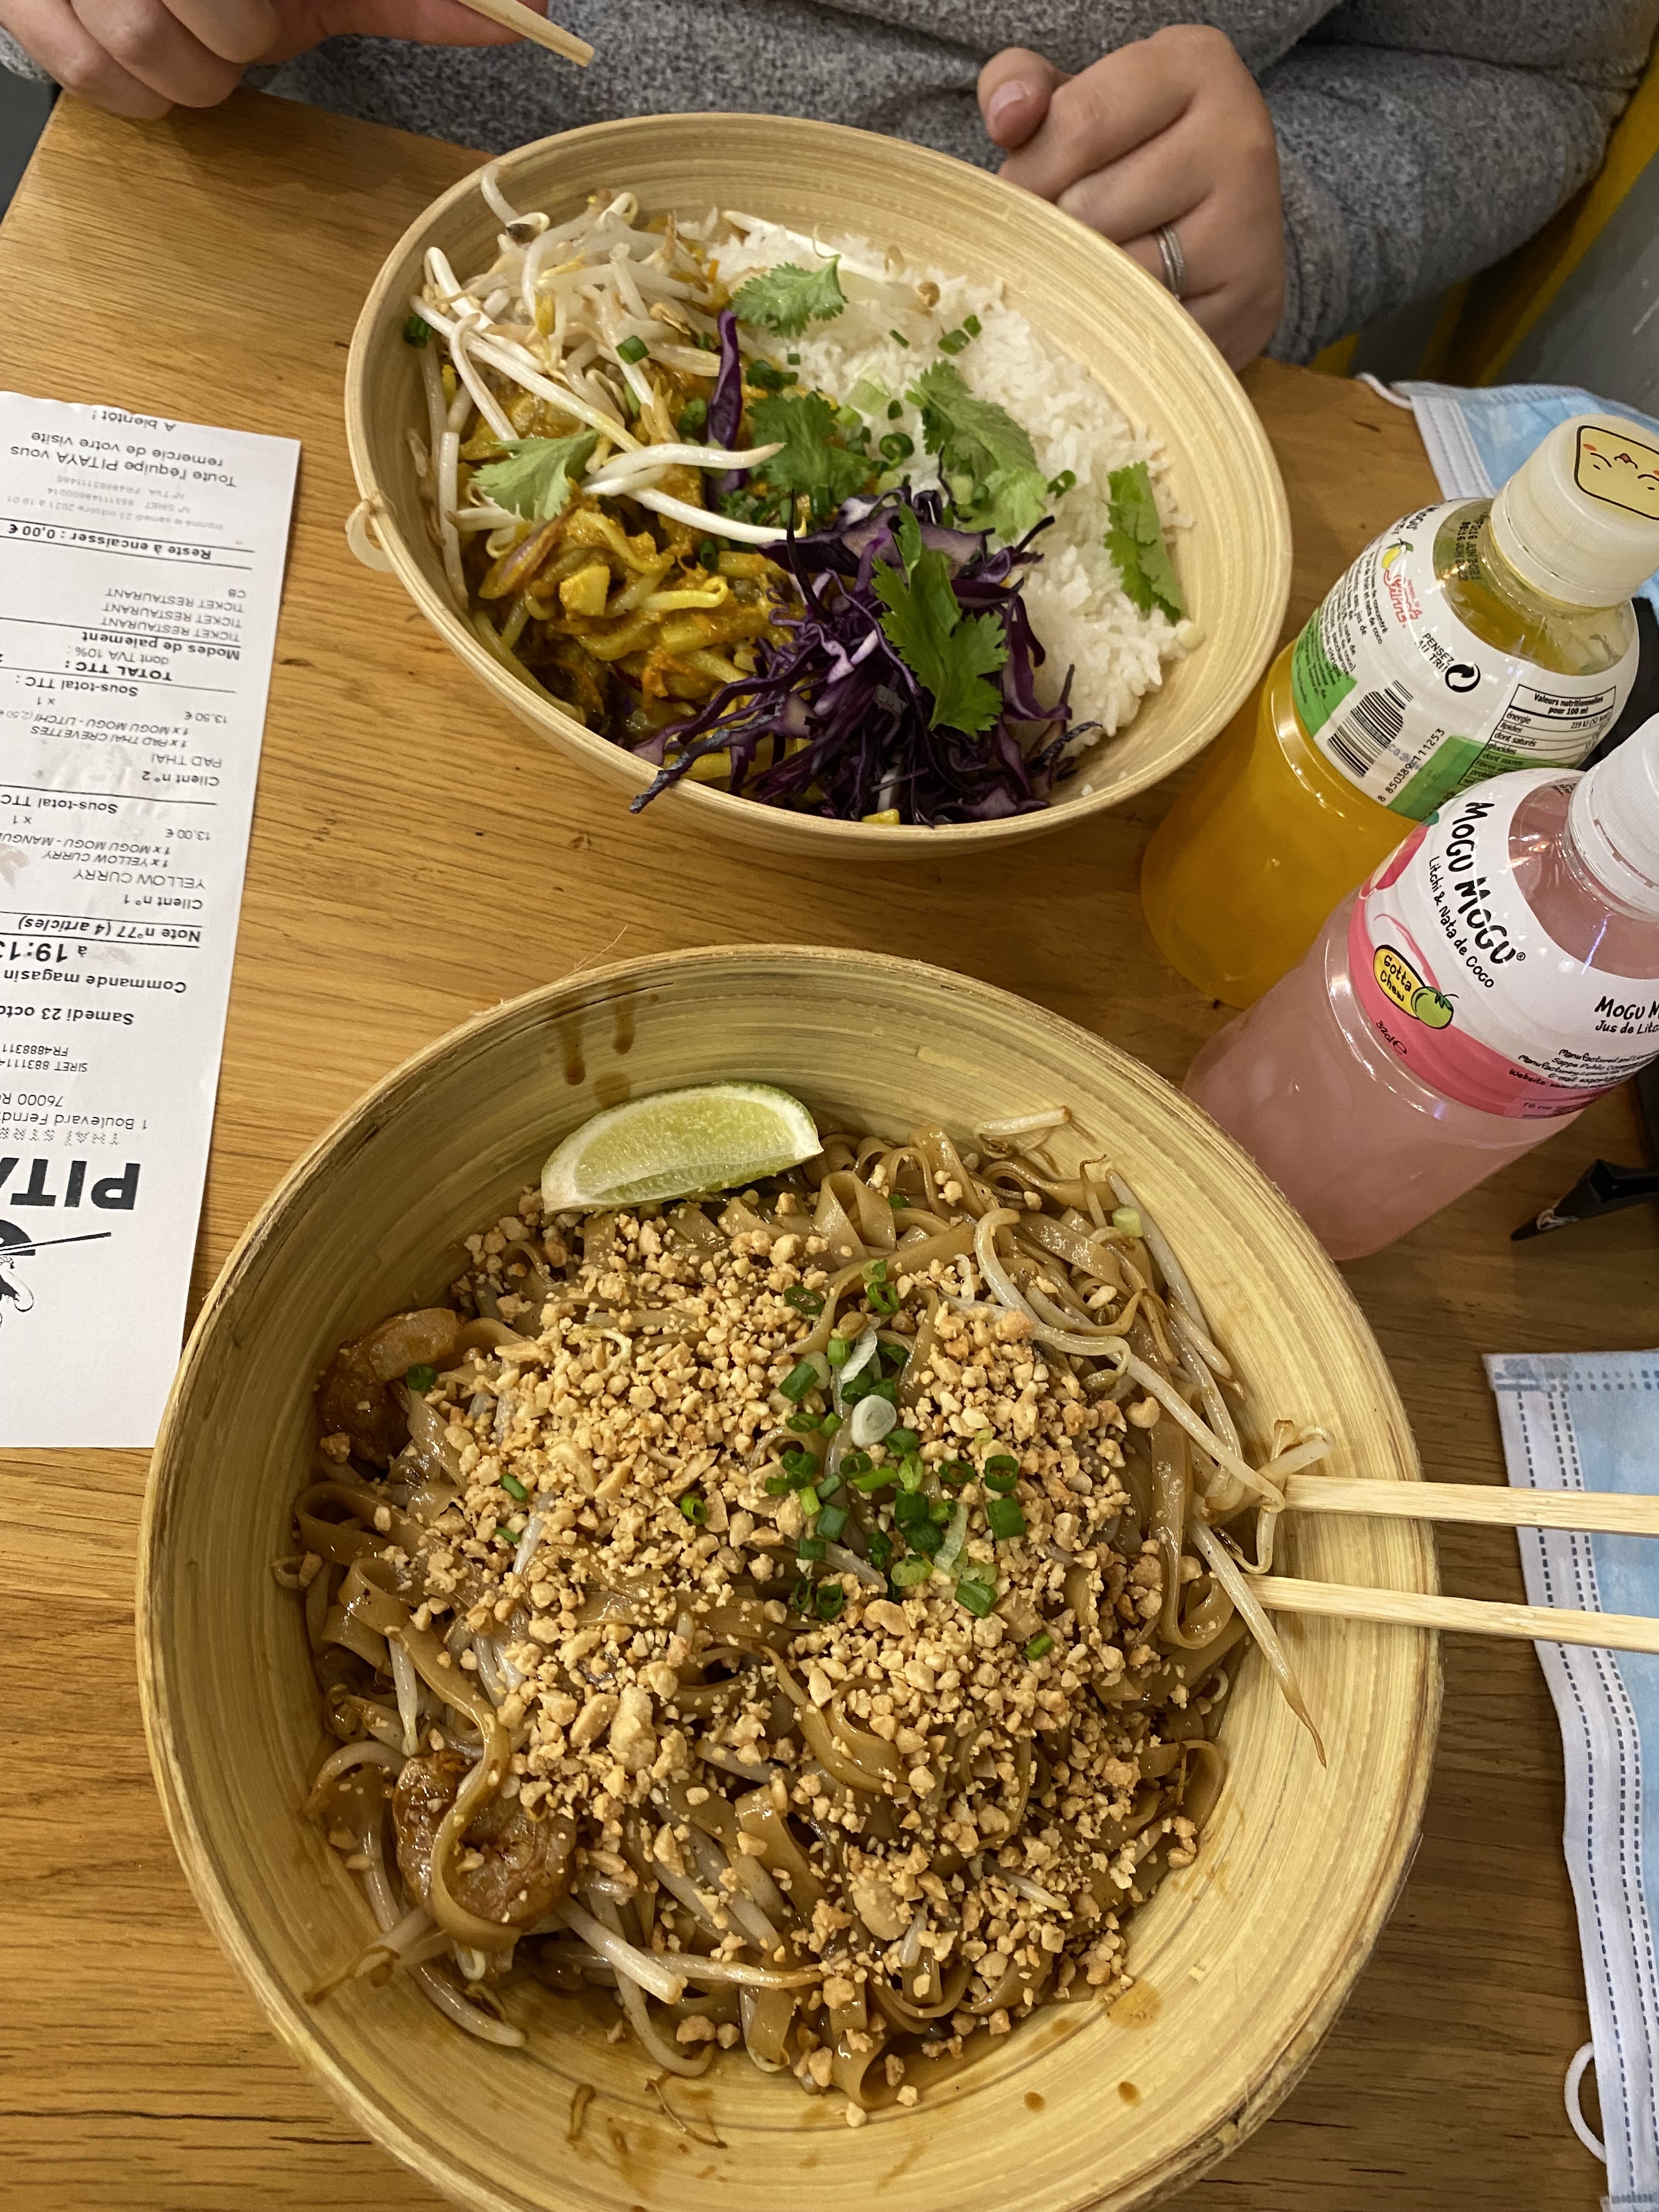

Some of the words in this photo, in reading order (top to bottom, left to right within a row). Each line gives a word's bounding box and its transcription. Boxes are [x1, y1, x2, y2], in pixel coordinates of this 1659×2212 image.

[102, 410, 157, 430] bientôt
[165, 422, 176, 432] A
[31, 432, 72, 447] visite
[79, 439, 119, 453] votre
[10, 446, 49, 460] vous
[126, 446, 146, 459] de
[153, 449, 223, 469] remercie
[57, 452, 118, 471] PITAYA
[125, 460, 186, 480] l'équipe
[193, 471, 235, 487] Toute
[8, 523, 18, 534] €
[23, 526, 55, 539] 0,00
[71, 533, 148, 550] encaisser
[154, 544, 162, 554] à
[168, 546, 211, 560] Reste
[105, 588, 194, 607] RESTAURANT
[228, 589, 246, 599] CB
[102, 603, 191, 622] RESTAURANT
[198, 600, 244, 613] TICKET
[99, 617, 189, 636] RESTAURANT
[196, 615, 242, 627] TICKET
[81, 631, 157, 648] paiement
[195, 629, 240, 641] TICKET
[75, 647, 103, 657] 10%
[163, 642, 182, 653] de
[188, 645, 240, 661] Modes
[109, 651, 135, 662] TVA
[140, 654, 168, 665] dont
[76, 662, 108, 674] TTC
[117, 666, 172, 681] TOTAL
[25, 677, 55, 689] TTC
[61, 681, 138, 697] Sous-total
[1534, 693, 1559, 706] Valeurs
[34, 714, 76, 726] LITCHI
[1506, 711, 1531, 724] énergie
[86, 719, 127, 731] MOGU
[130, 724, 171, 735] MOGU
[1499, 722, 1522, 733] lipides
[31, 726, 107, 741] CREVETTES
[110, 735, 139, 744] THAI
[1494, 731, 1511, 741] dont
[1513, 737, 1537, 747] saturés
[142, 737, 168, 747] PAD
[151, 754, 186, 765] THAI
[192, 756, 222, 768] PAD
[142, 771, 150, 780] 2
[176, 775, 219, 786] Client
[1, 794, 31, 806] TTC
[38, 798, 118, 814] Sous-total
[165, 829, 173, 837] €
[1446, 802, 1495, 872] MOGU
[64, 839, 106, 850] MOGU
[109, 843, 151, 854] MOGU
[43, 850, 90, 862] CURRY
[93, 854, 148, 867] YELLOW
[73, 869, 132, 883] CURRY
[1429, 856, 1444, 892] Litchi
[137, 874, 205, 889] YELLOW
[124, 895, 129, 904] 1
[158, 896, 202, 910] Client
[1434, 891, 1445, 906] &
[18, 916, 89, 932] articles)
[1439, 905, 1457, 939] Nata
[94, 922, 111, 936] (4
[162, 929, 201, 942] Note
[77, 945, 87, 957] à
[1454, 938, 1468, 956] de
[4, 969, 80, 983] magasin
[1384, 955, 1412, 992] Gotta
[1466, 956, 1494, 988] Coco
[86, 976, 187, 993] Commande
[1380, 970, 1404, 1001] Chew
[42, 1008, 62, 1020] 23
[1594, 996, 1645, 1020] MOGU
[66, 1008, 134, 1025] Samedi
[1596, 1020, 1617, 1033] Jus
[1620, 1022, 1634, 1034] de
[3, 1044, 68, 1056] FR4888311
[54, 1062, 88, 1072] SIRET
[18, 1094, 64, 1107] 76000
[0, 1112, 48, 1125] Fernd
[54, 1115, 134, 1130] Boulevard
[142, 1120, 146, 1130] 1
